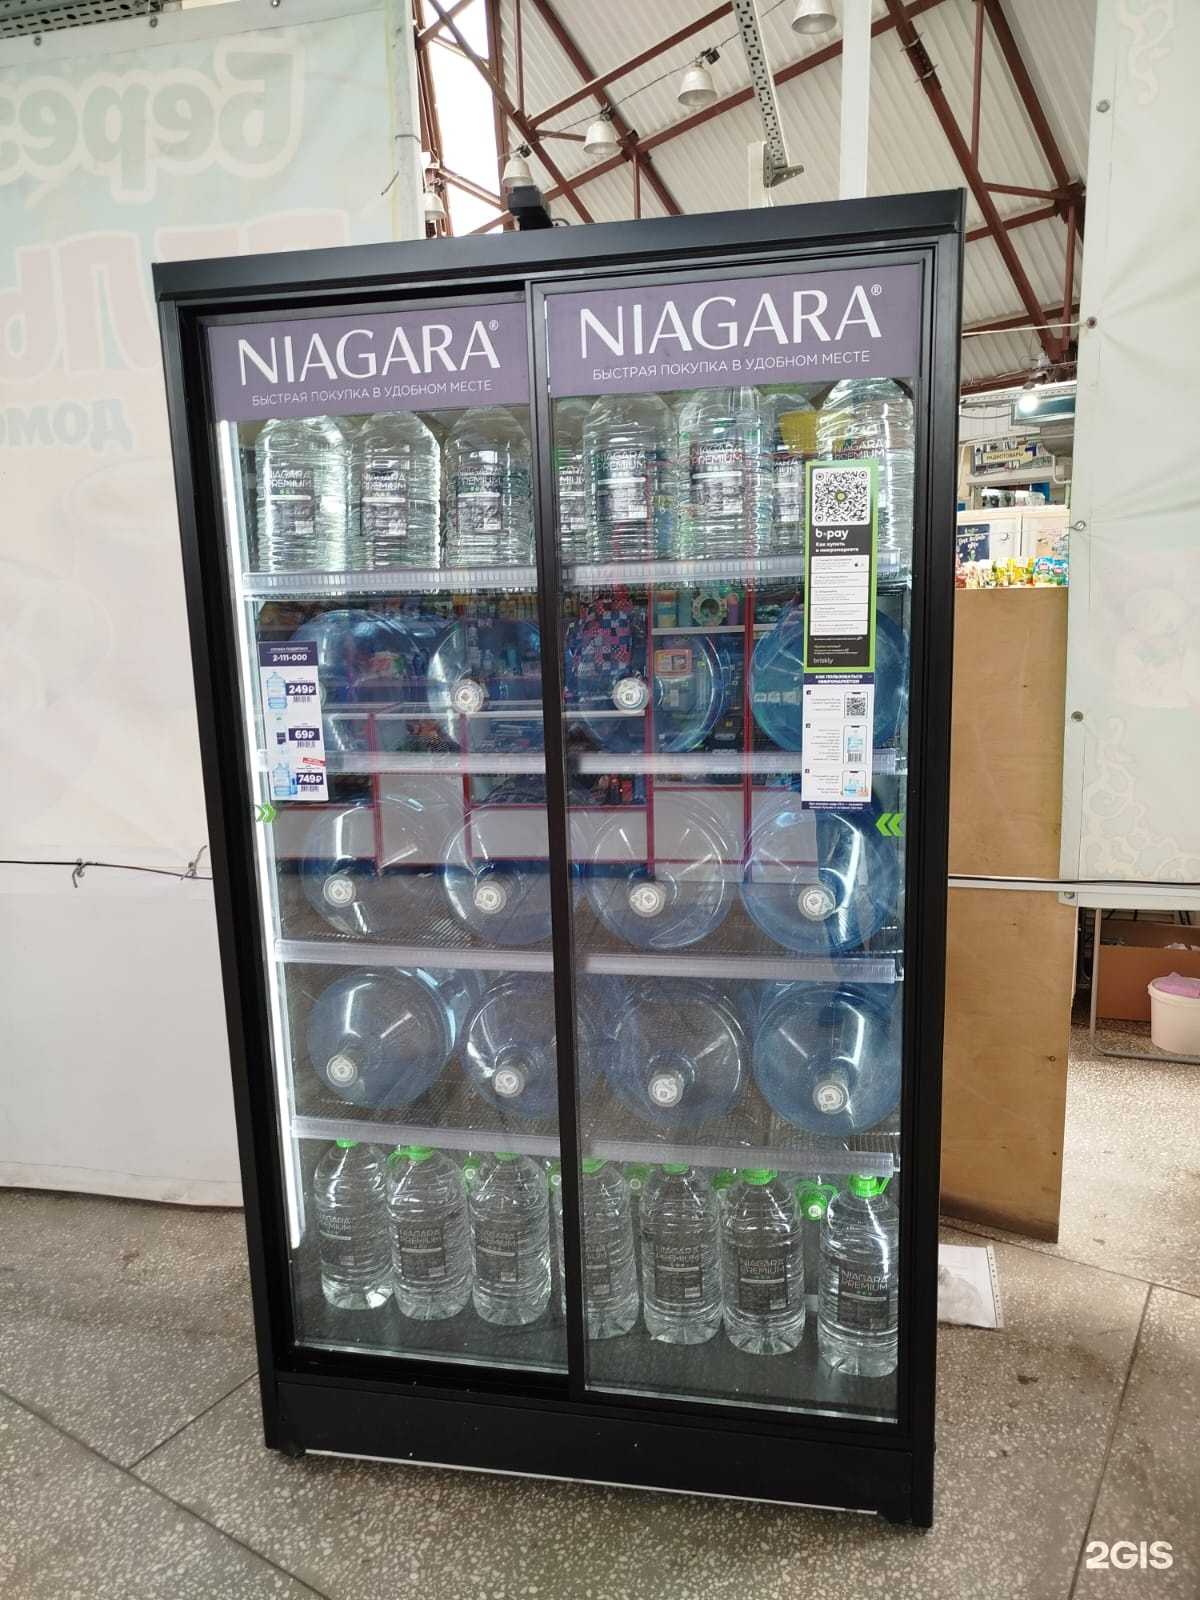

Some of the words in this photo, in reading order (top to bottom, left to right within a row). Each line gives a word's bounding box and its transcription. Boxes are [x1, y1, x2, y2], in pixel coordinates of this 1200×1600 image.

[592, 364, 657, 381] БЫСТРАЯ
[661, 360, 728, 377] ПОКУПКА
[733, 358, 743, 371] В
[746, 354, 818, 371] УДОБНОМ
[822, 350, 871, 364] МЕСТЕ
[252, 391, 308, 407] БЫСТРАЯ
[311, 388, 369, 403] ПОКУПКА
[373, 386, 382, 398] В
[385, 381, 447, 399] УДОБНОМ
[451, 379, 492, 393] МЕСТЕ
